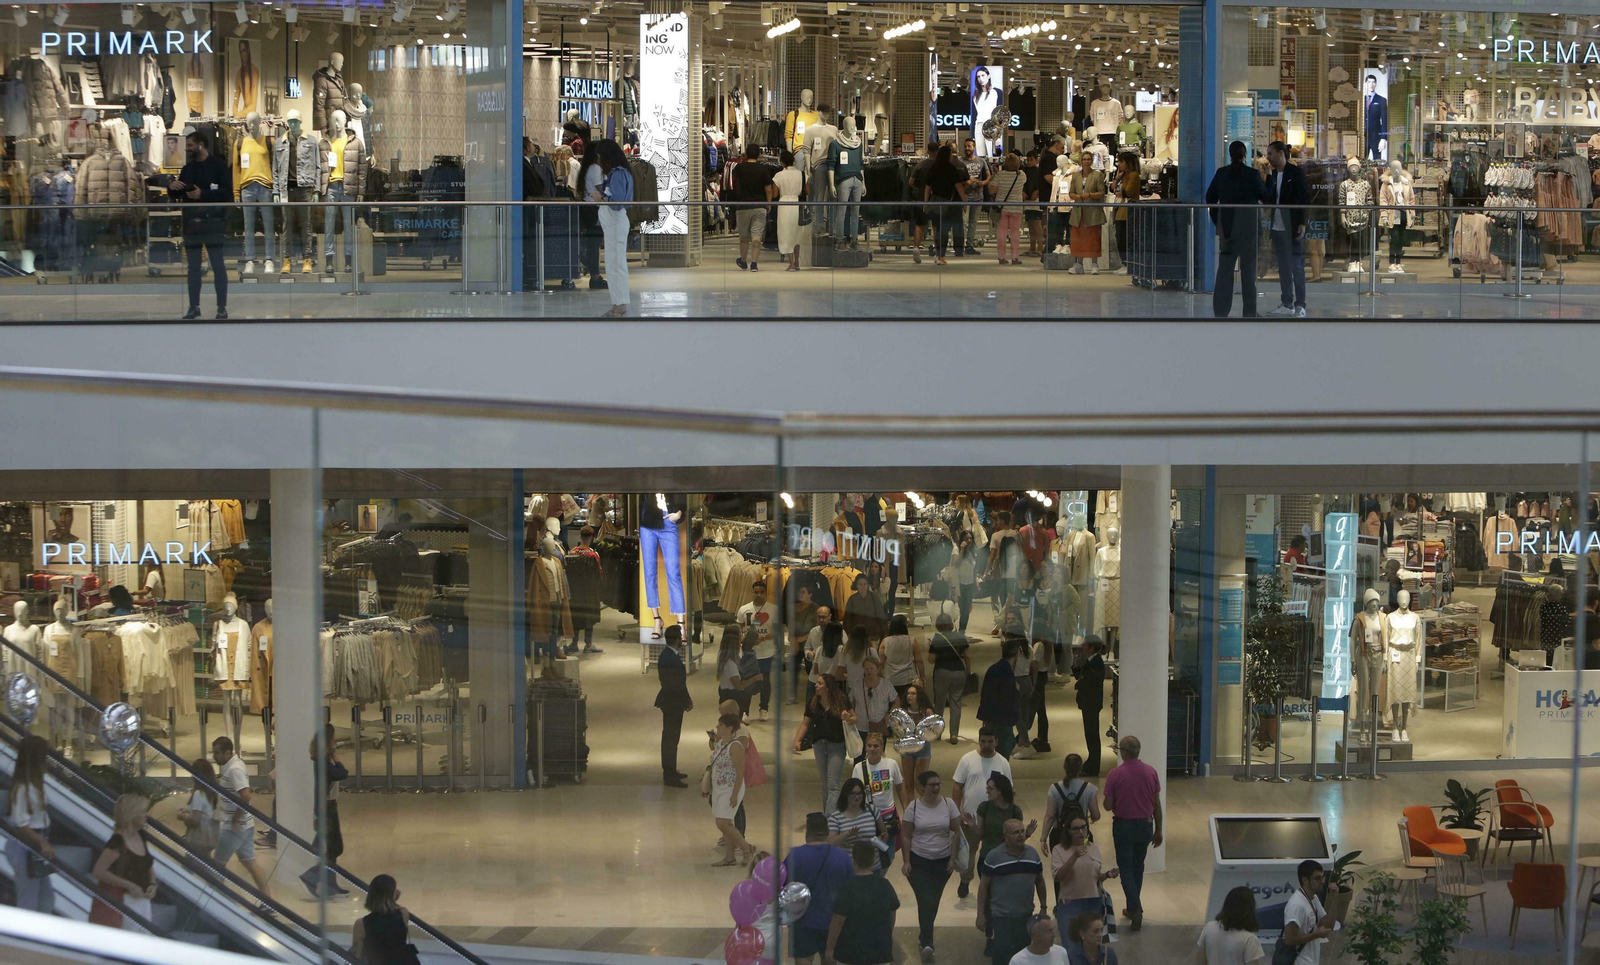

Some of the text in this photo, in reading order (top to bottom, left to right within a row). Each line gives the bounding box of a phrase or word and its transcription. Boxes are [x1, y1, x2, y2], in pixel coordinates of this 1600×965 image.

[41, 30, 213, 56] PRIMARK
[645, 34, 668, 44] ING
[645, 45, 675, 55] NOW
[1494, 39, 1600, 63] PRIMA
[564, 78, 613, 99] ESCALERAS
[393, 219, 462, 229] PRIMARKE
[1497, 530, 1600, 554] PRIMA
[42, 541, 213, 566] PRIMARK
